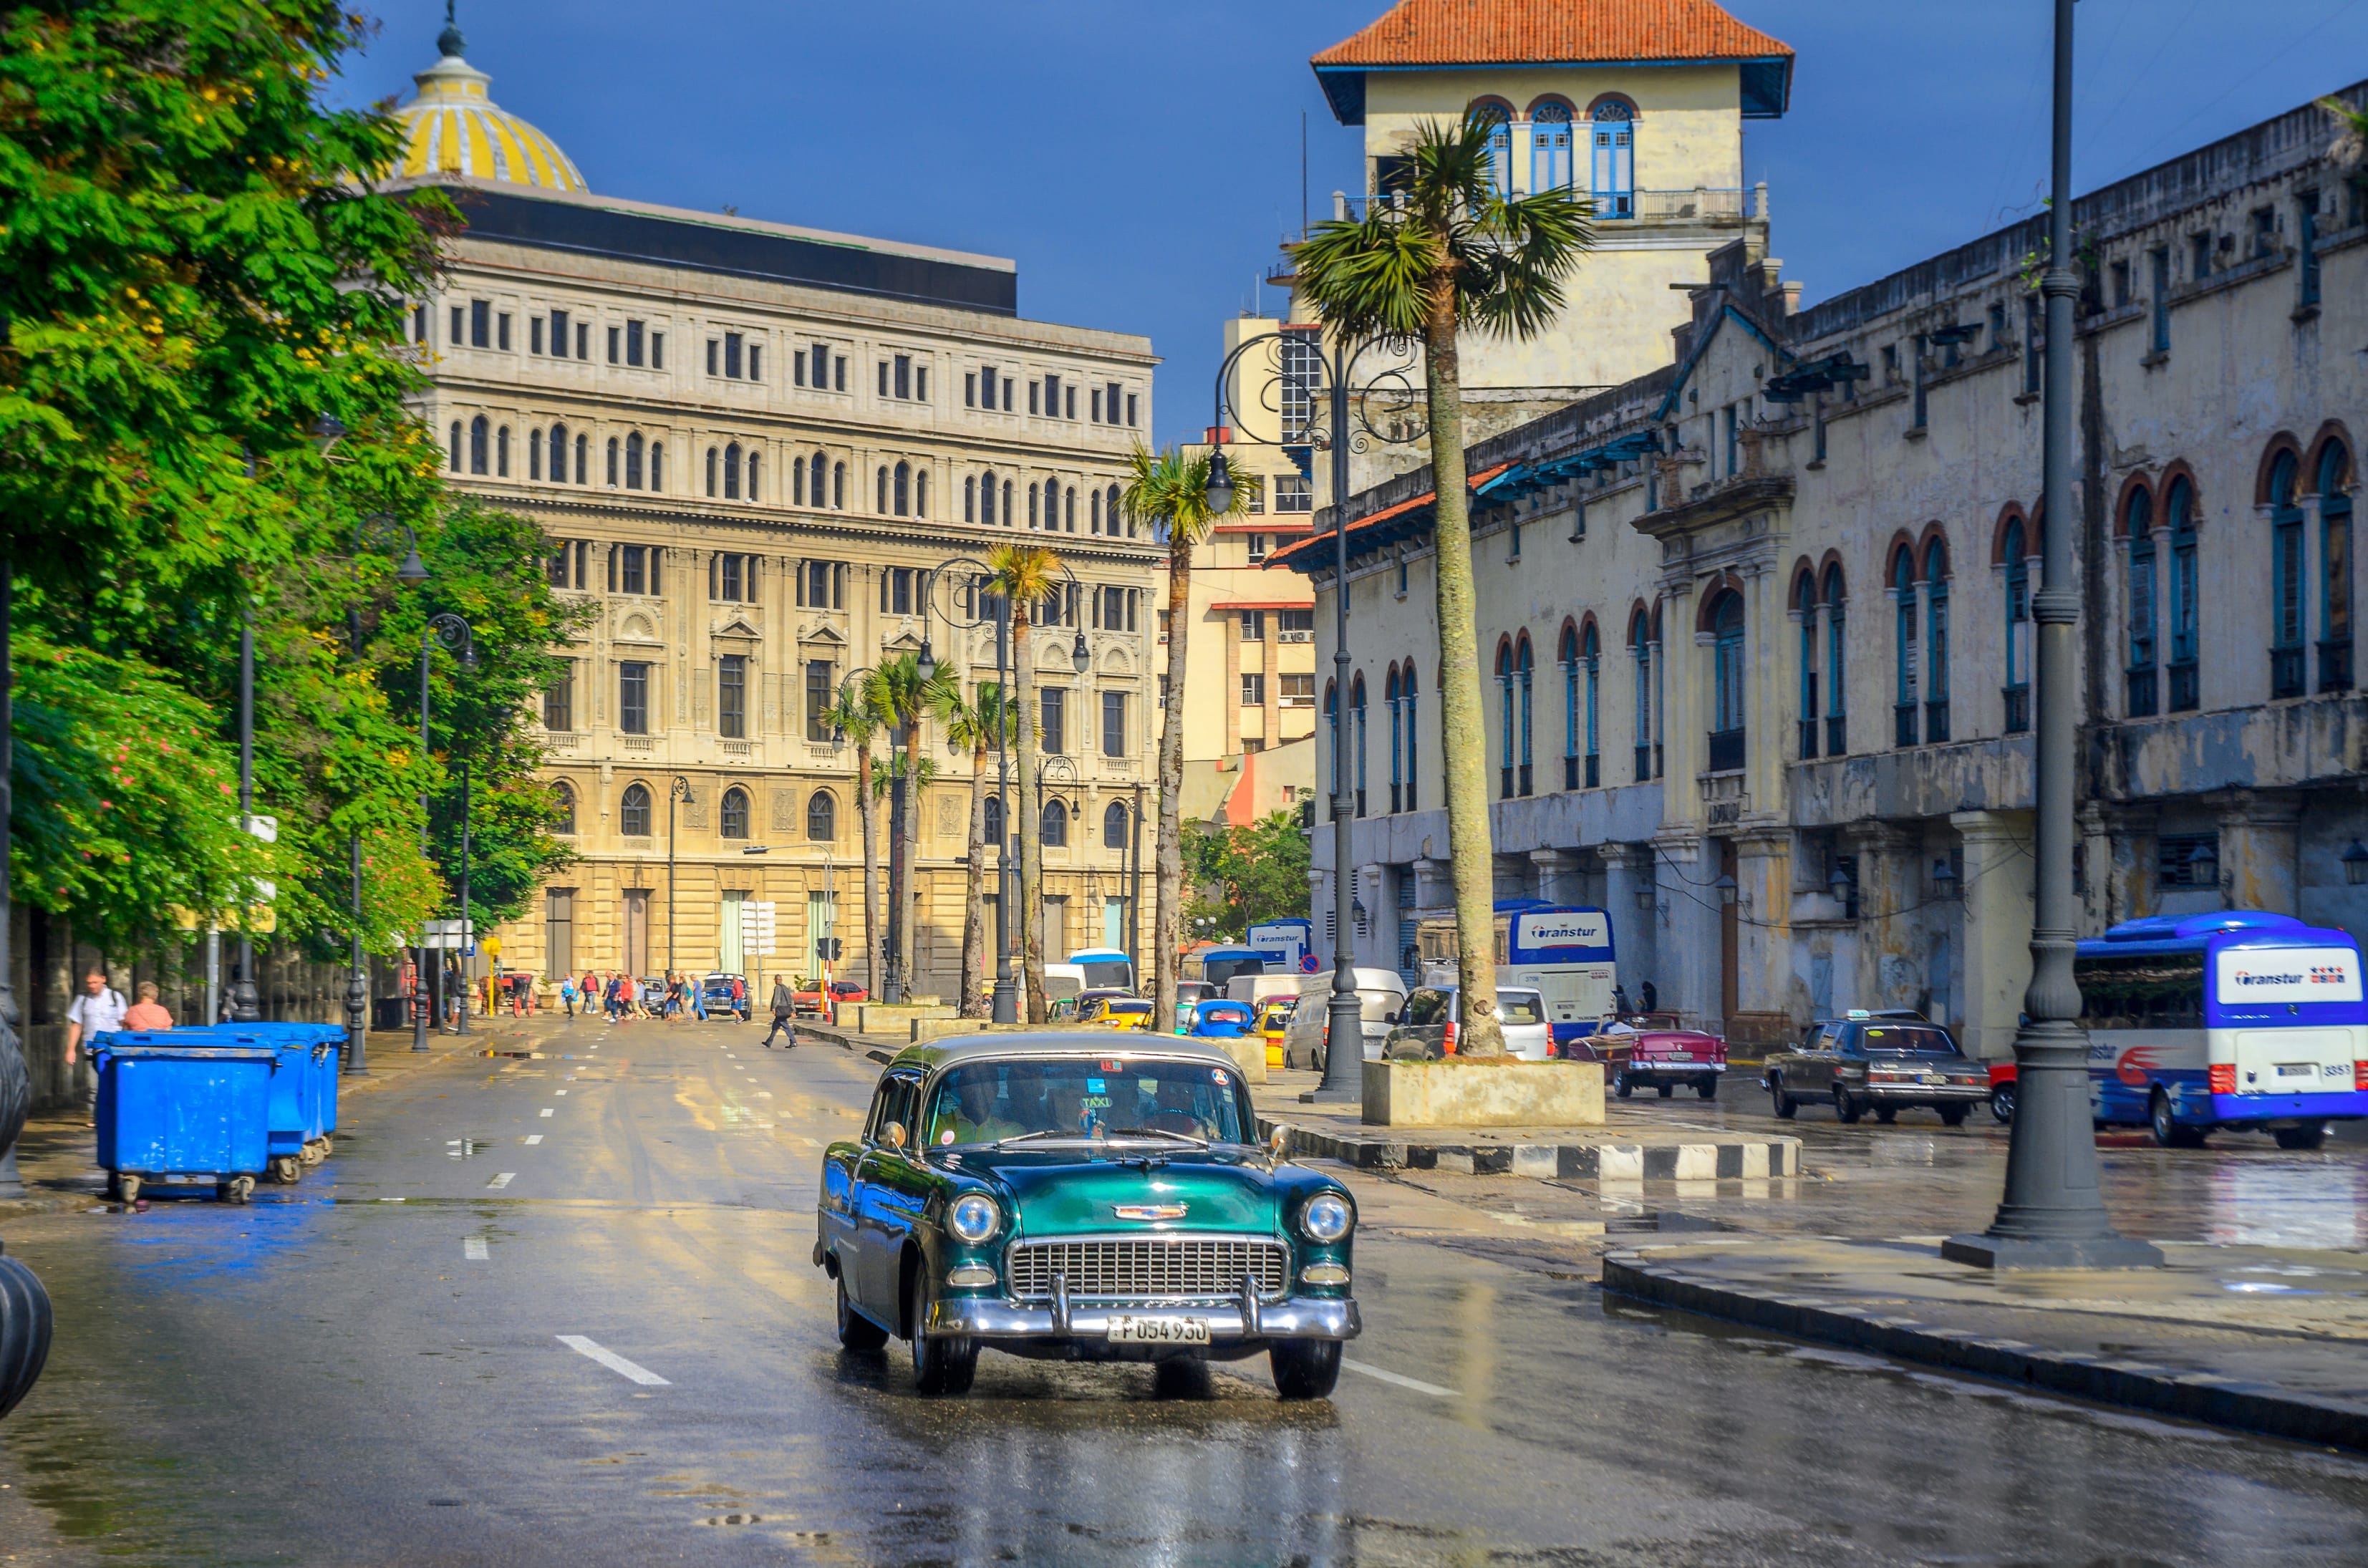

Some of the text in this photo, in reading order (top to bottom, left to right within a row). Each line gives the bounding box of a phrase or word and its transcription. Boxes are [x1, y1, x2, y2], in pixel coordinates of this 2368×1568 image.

[1532, 925, 1597, 938] Transtur
[2235, 971, 2304, 986] Transtur
[1082, 1098, 1109, 1108] TAXI
